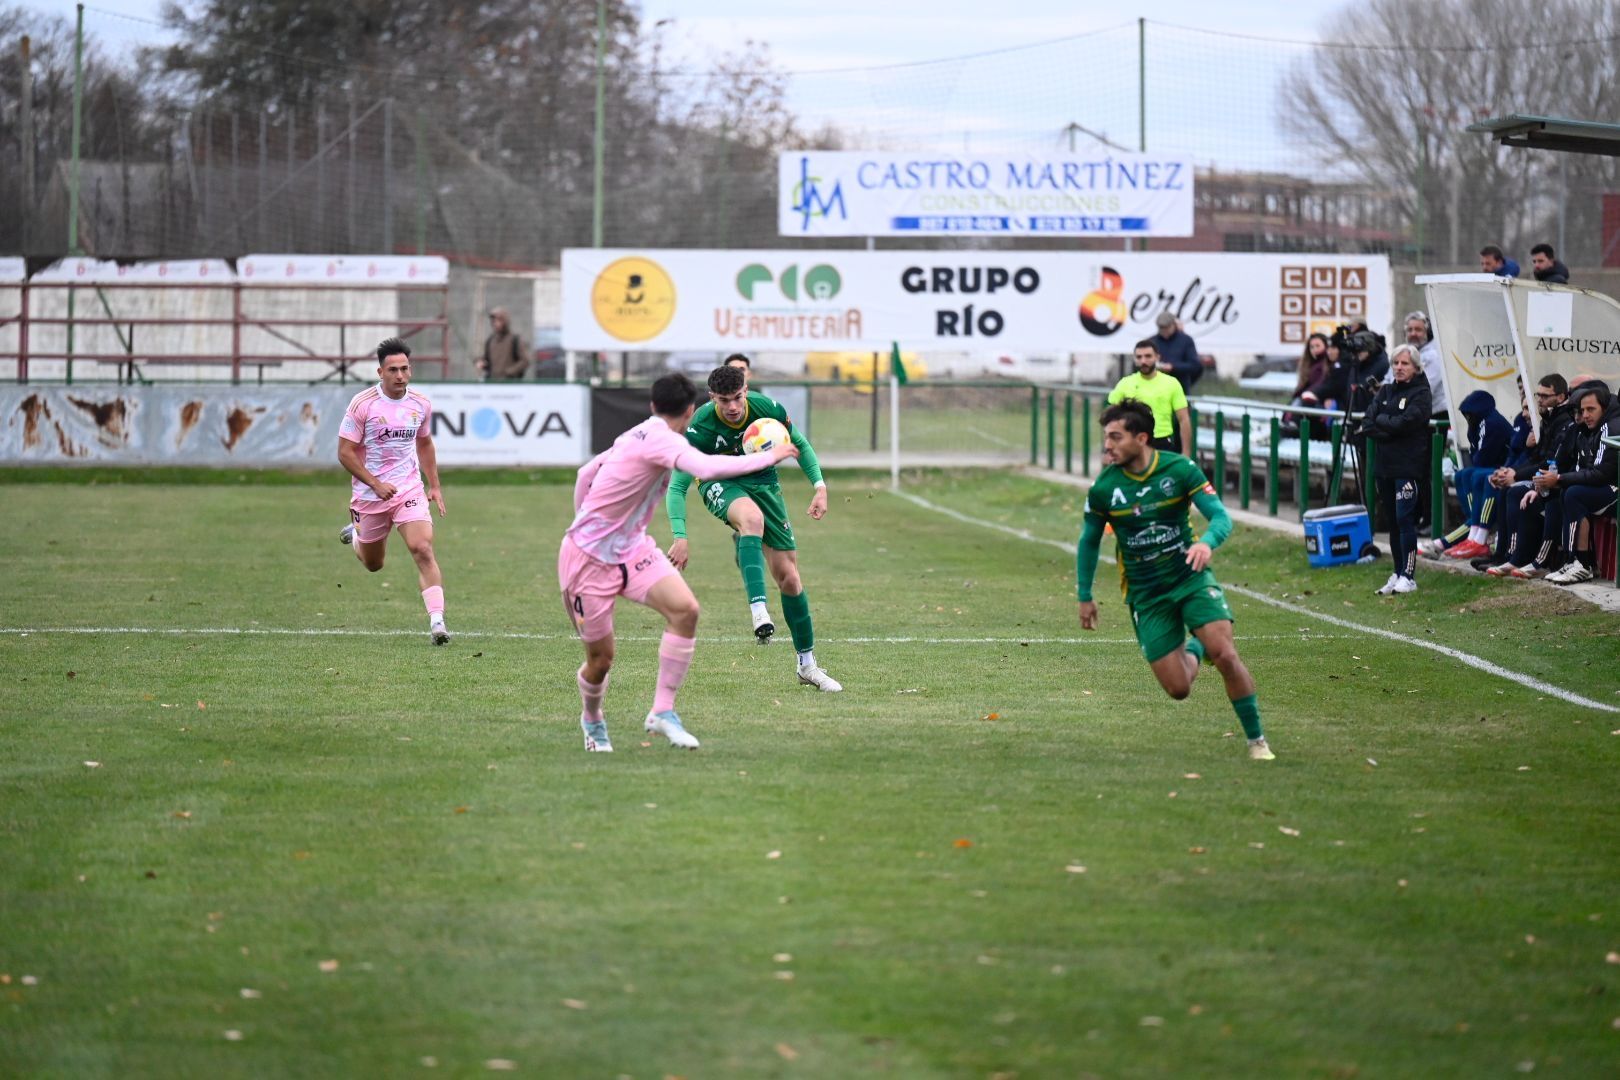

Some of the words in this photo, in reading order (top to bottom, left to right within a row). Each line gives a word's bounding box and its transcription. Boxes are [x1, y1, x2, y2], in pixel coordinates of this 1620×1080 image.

[857, 161, 990, 190] CASTRO
[1006, 158, 1184, 190] MARTÍNEZ
[920, 194, 1120, 211] CONSTRUCCIONES
[901, 266, 1040, 294] GRUPO
[936, 304, 1004, 337] RÍO
[1535, 337, 1620, 354] AUGUSTA
